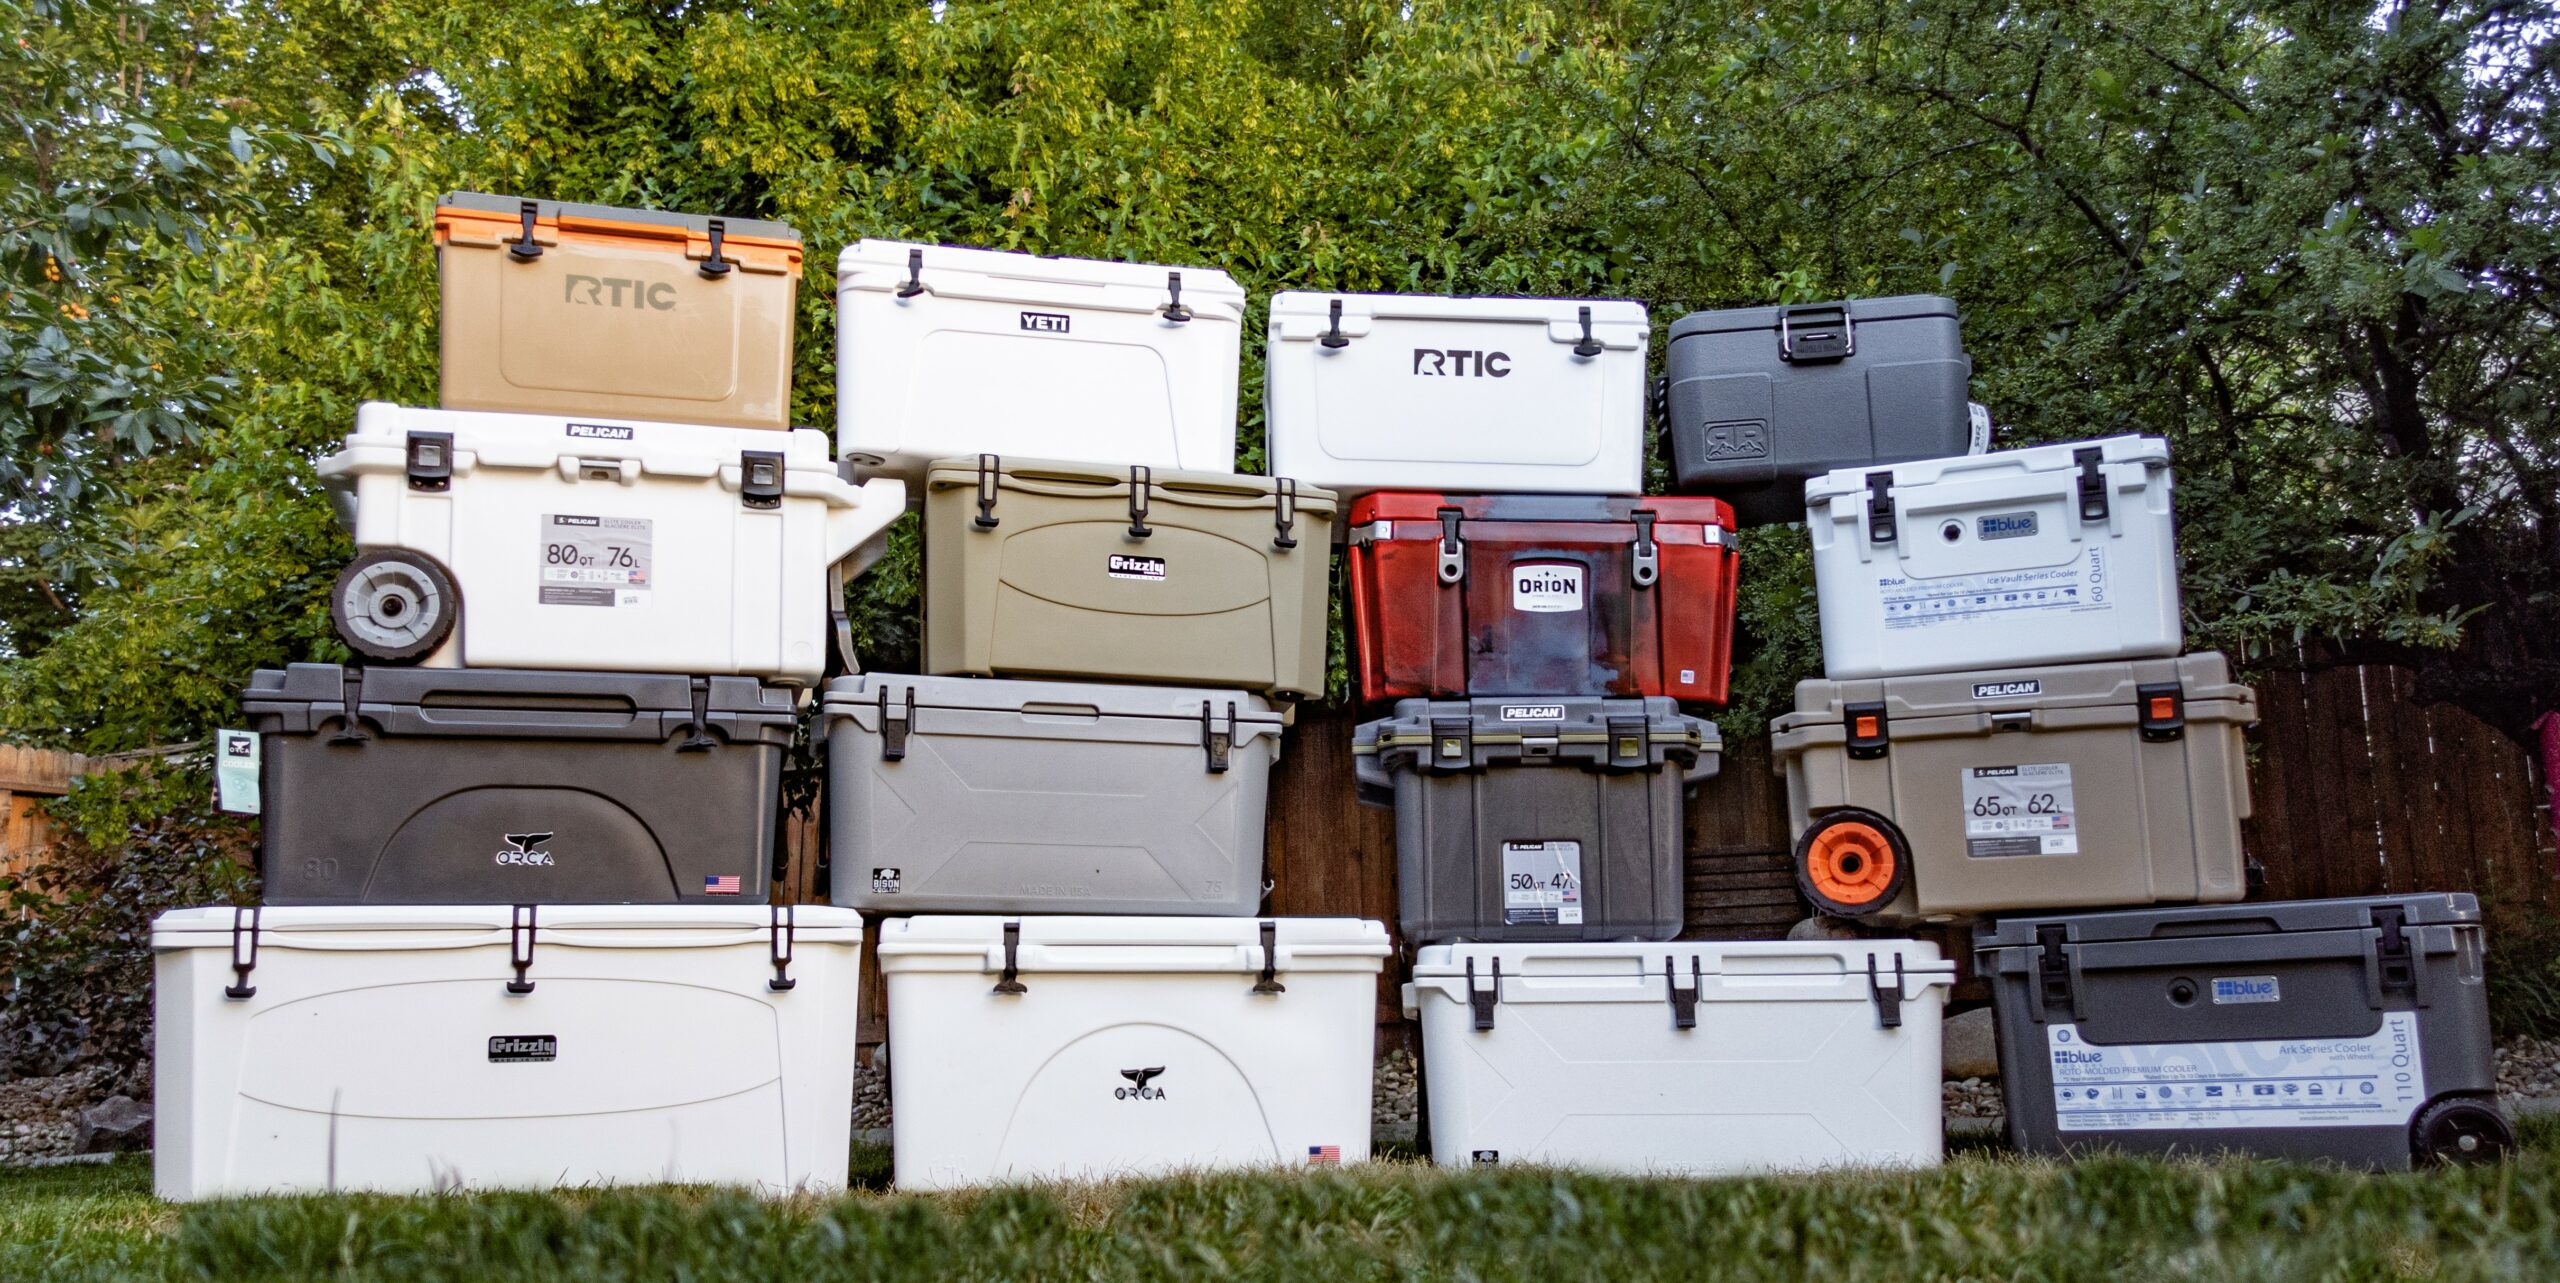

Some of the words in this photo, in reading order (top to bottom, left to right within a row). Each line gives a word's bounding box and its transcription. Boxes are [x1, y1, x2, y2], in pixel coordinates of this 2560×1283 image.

[565, 274, 677, 311] RTIC
[1022, 314, 1067, 331] YETI
[1414, 348, 1511, 378] RTIC
[570, 425, 630, 439] PELICAN
[1997, 517, 2033, 531] blue
[1110, 556, 1165, 575] Grizzly
[2088, 547, 2103, 584] Quart
[1887, 578, 1906, 586] blue
[2001, 574, 2023, 583] Vault
[2024, 572, 2048, 580] Series
[2050, 570, 2078, 579] Cooler
[1519, 578, 1576, 594] ORION
[2091, 587, 2104, 602] 60
[1978, 682, 2035, 696] PELICAN
[1506, 708, 1559, 718] PELICAN
[496, 850, 555, 865] ORCA
[873, 880, 900, 888] BISON
[2233, 980, 2273, 994] blue
[490, 1038, 556, 1055] Grizzly
[2279, 1045, 2298, 1055] Ark
[2300, 1044, 2332, 1054] Series
[2335, 1043, 2371, 1053] Cooler
[2389, 1019, 2409, 1067] Quart
[2068, 1050, 2103, 1063] blue
[2122, 1066, 2162, 1074] PREMIUM
[2163, 1065, 2198, 1073] COOLER
[1115, 1087, 1166, 1100] ORCA
[2394, 1072, 2413, 1102] 110
